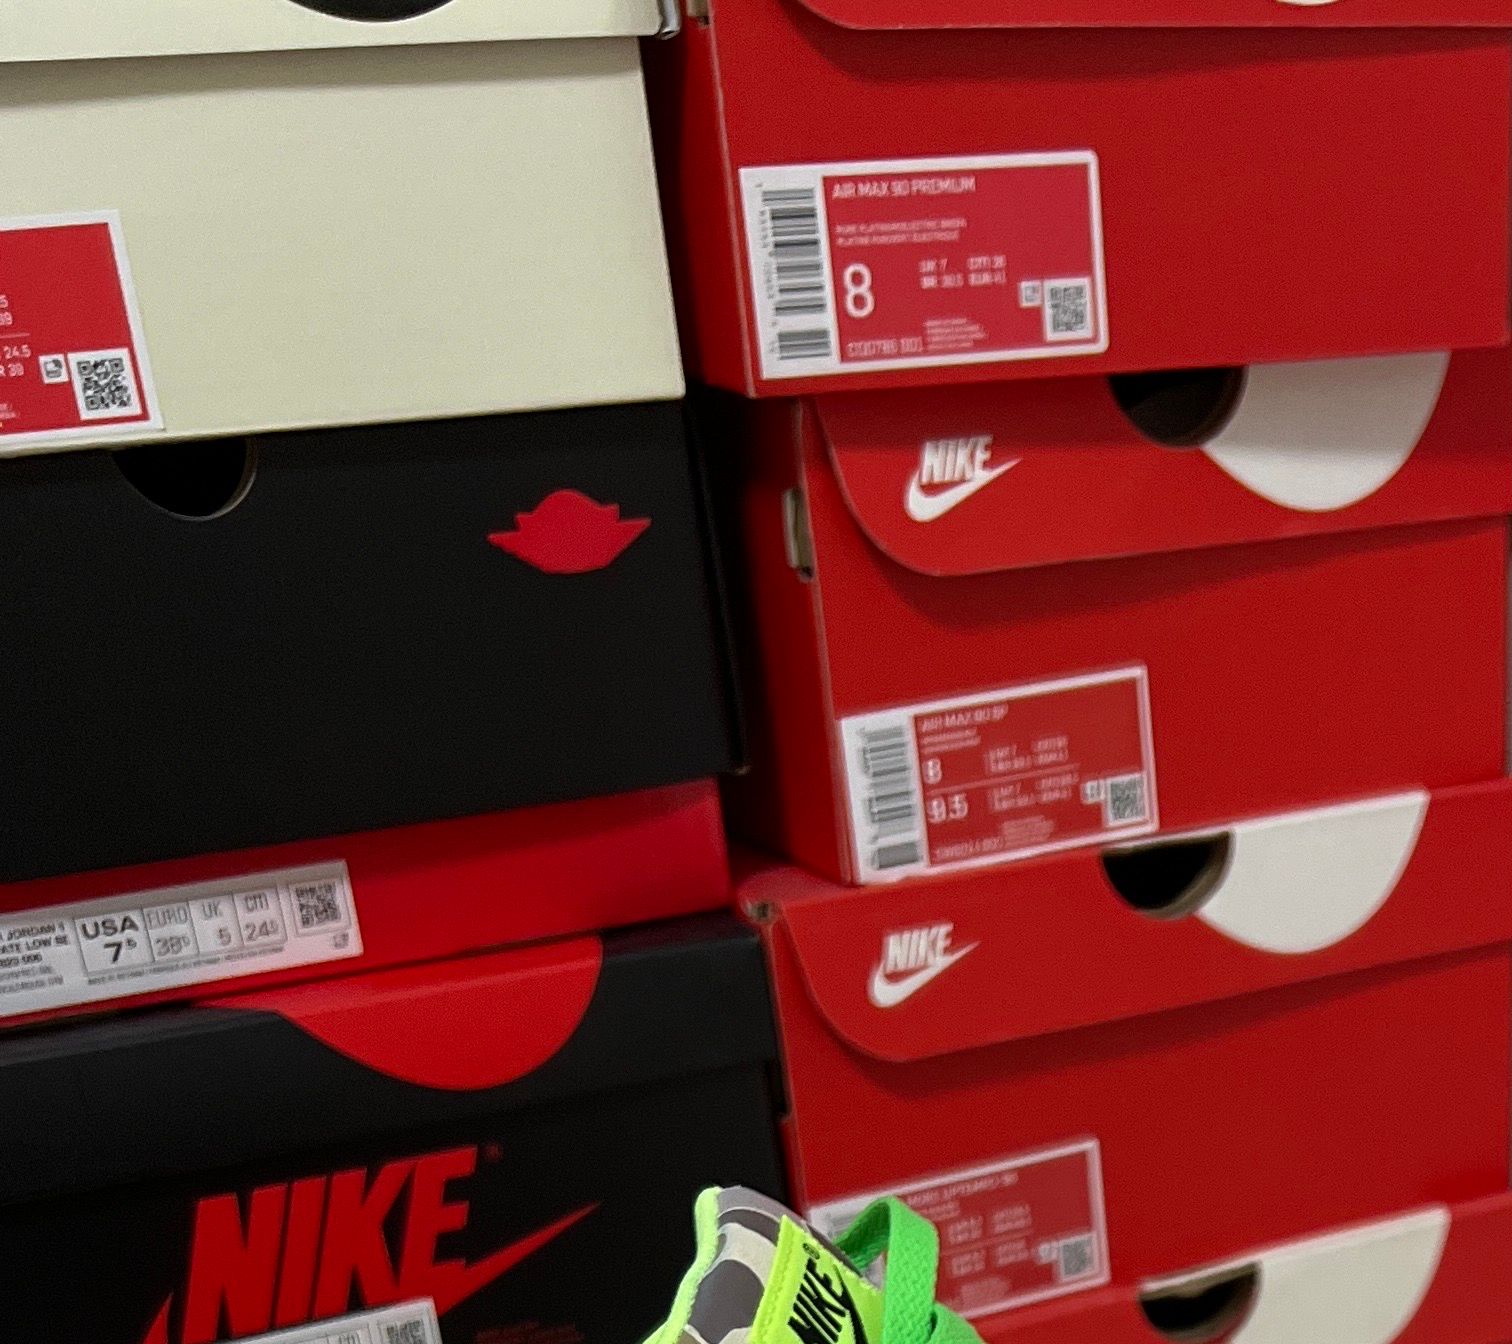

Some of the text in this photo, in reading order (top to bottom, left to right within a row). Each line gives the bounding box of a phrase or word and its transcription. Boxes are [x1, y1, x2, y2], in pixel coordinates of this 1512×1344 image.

[843, 263, 875, 318] 8
[4, 344, 32, 360] 24.5
[920, 434, 994, 486] NIKE
[81, 915, 140, 940] USA
[201, 901, 223, 920] UK
[884, 922, 954, 973] NIKE
